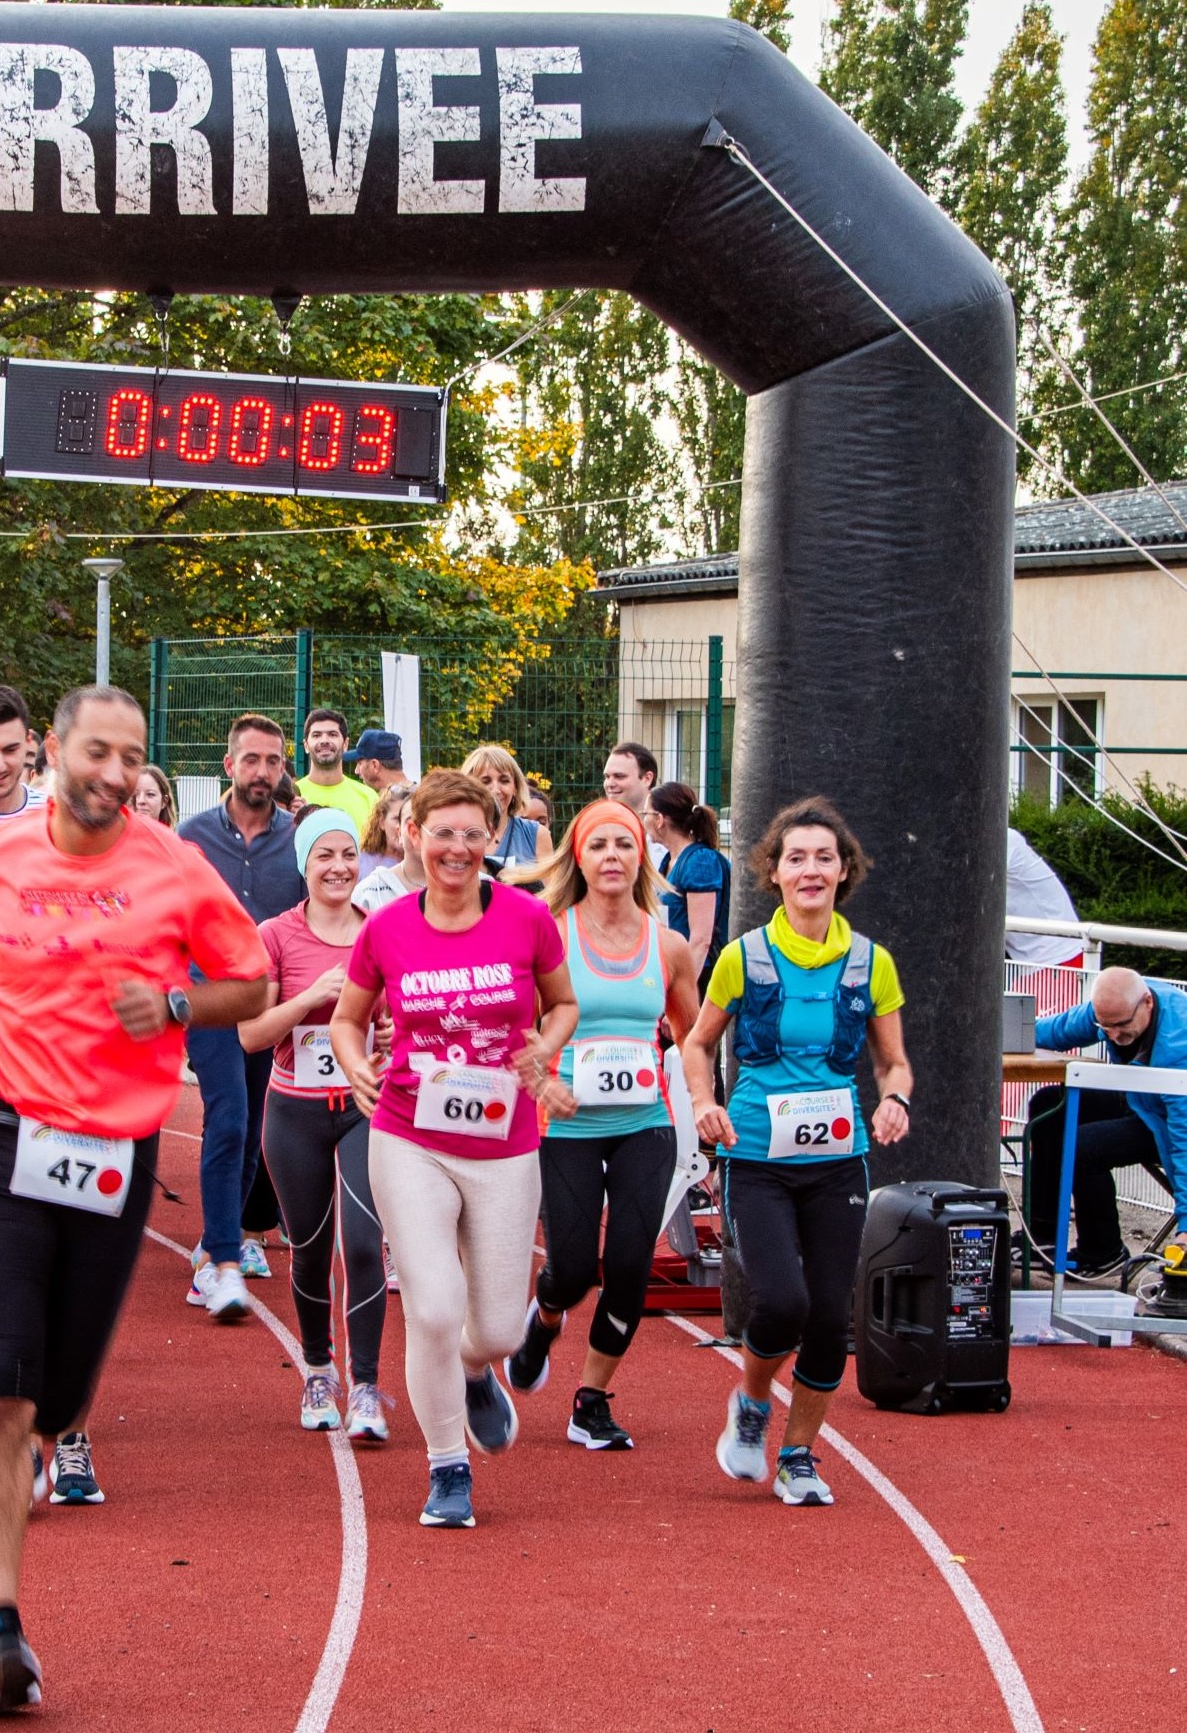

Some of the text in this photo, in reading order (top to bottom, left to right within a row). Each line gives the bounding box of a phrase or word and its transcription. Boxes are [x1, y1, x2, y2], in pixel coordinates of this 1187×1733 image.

[105, 388, 395, 475] 0:00:03
[400, 962, 514, 997] OCTOBRE ROSE
[400, 988, 517, 1013] MARCHE COURSE
[317, 1054, 339, 1076] 3
[598, 1070, 634, 1093] 30
[444, 1095, 484, 1124] 60
[794, 1122, 829, 1146] 62
[47, 1156, 97, 1192] 47
